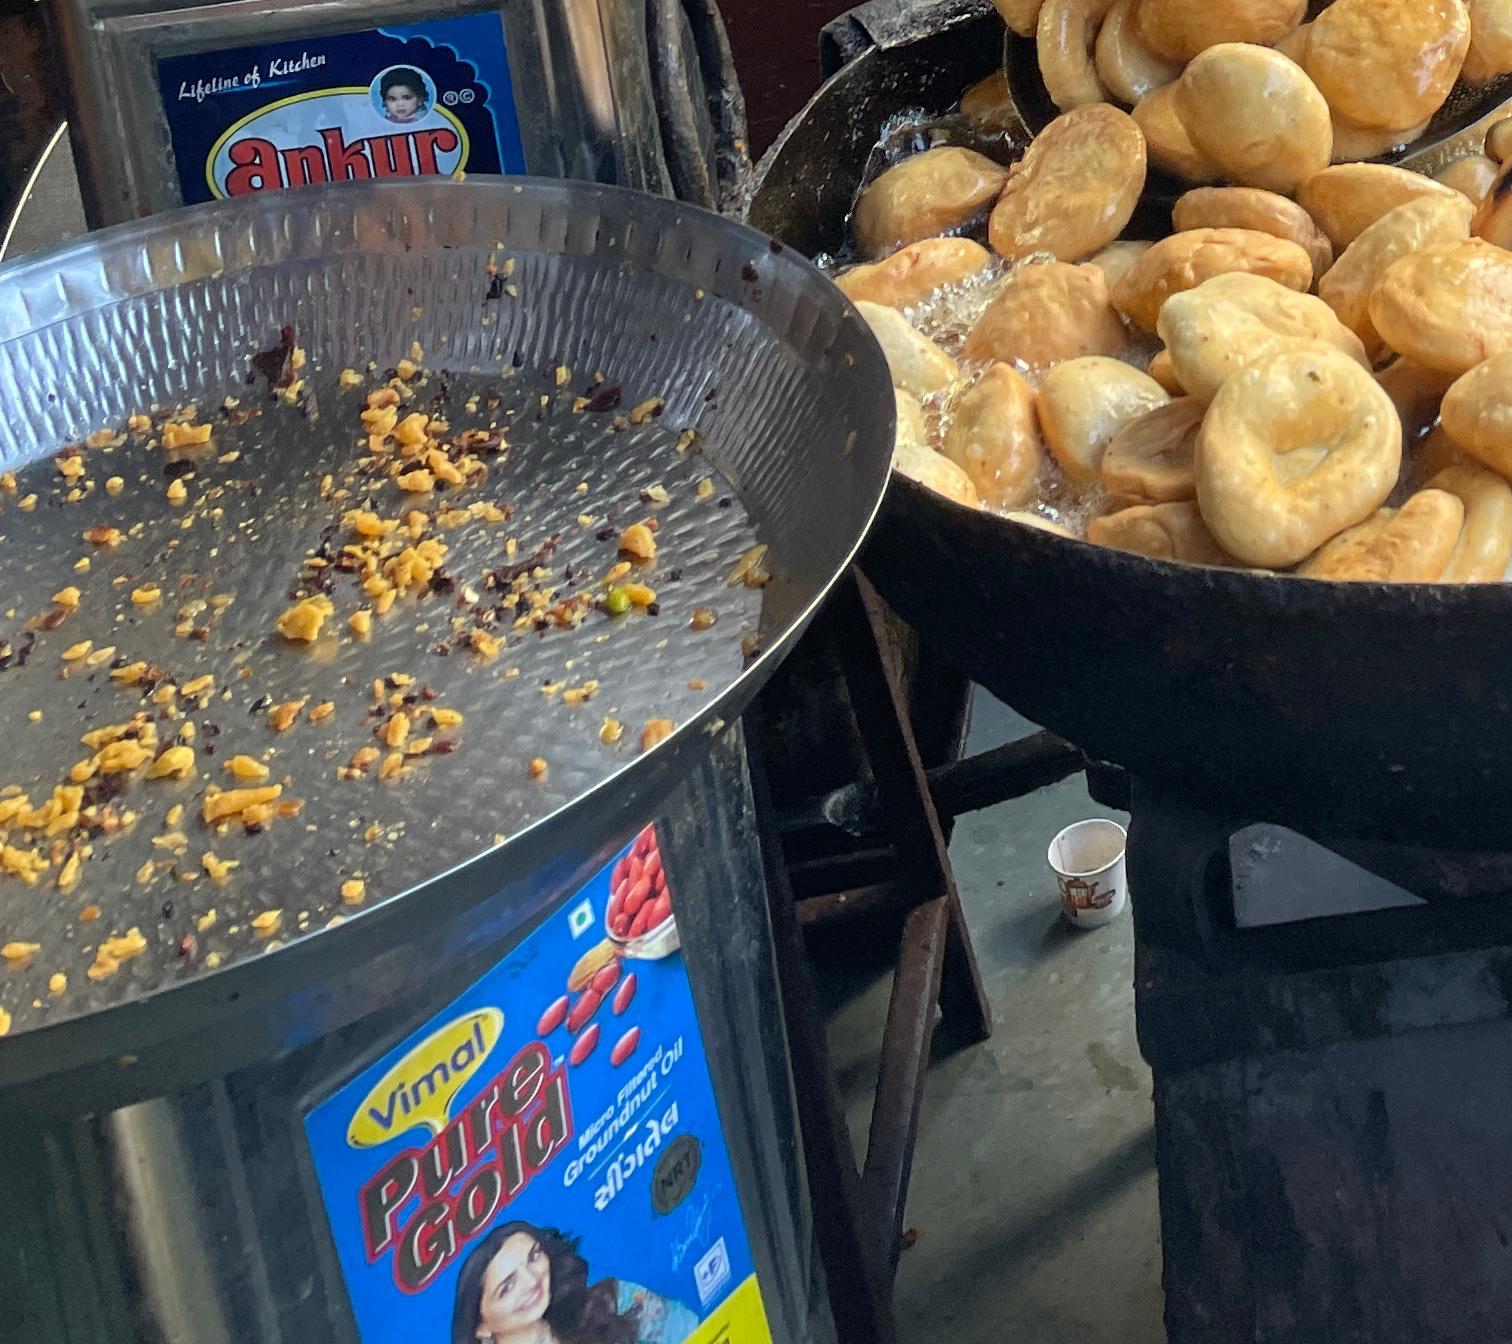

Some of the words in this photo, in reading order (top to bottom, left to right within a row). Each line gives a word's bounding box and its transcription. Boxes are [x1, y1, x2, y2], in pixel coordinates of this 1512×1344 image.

[178, 75, 240, 103] Lifeline
[243, 65, 261, 89] of
[269, 52, 326, 79] Kitchen
[369, 1021, 487, 1131] Vimal
[563, 1076, 658, 1187] Groundnut
[660, 1035, 683, 1077] Oil
[578, 1105, 613, 1151] Micro
[617, 1044, 663, 1108] Filtered
[364, 1049, 546, 1254] Pure
[400, 1075, 569, 1287] Gold
[594, 1100, 680, 1212] સીંગતેલ
